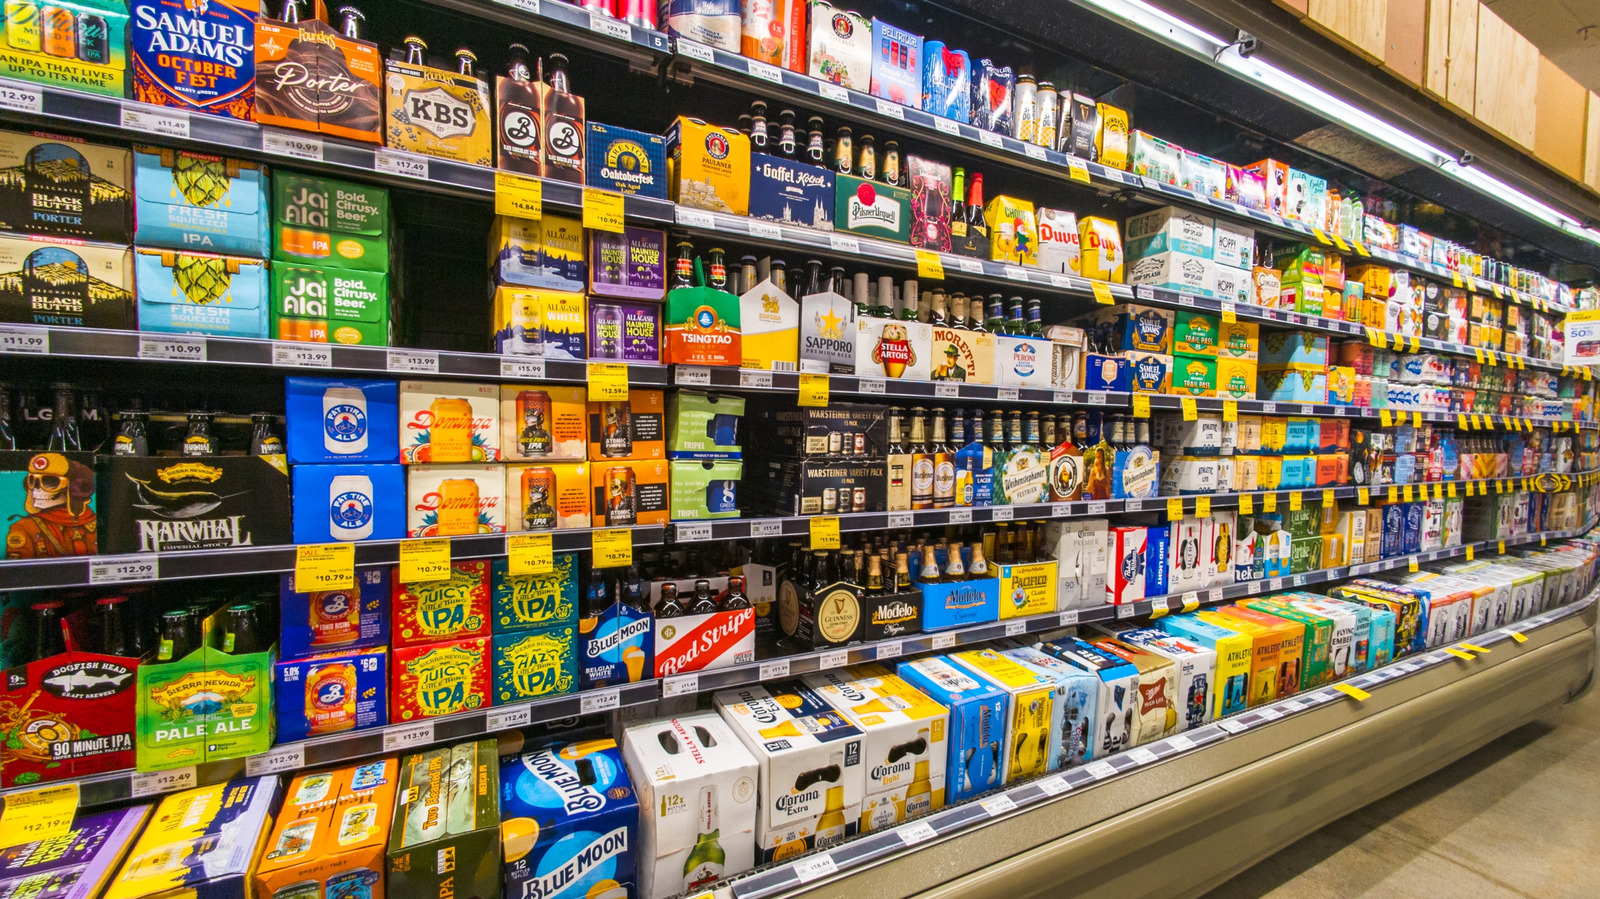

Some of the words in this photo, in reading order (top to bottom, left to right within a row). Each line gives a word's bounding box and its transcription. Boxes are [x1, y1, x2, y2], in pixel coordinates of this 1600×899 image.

[136, 5, 254, 51] SAMUEL
[772, 22, 782, 34] 4x
[298, 28, 336, 50] Founders
[654, 38, 662, 46] 5
[148, 32, 244, 68] ADAMS
[15, 57, 42, 69] IPA
[44, 63, 78, 77] THAT
[81, 70, 114, 81] LIVES
[157, 53, 237, 79] OCTOBER
[8, 64, 26, 76] UP
[28, 67, 47, 79] TO
[49, 70, 68, 82] ITS
[69, 74, 106, 88] NAME
[176, 70, 218, 88] FEST
[274, 62, 364, 93] Porter
[423, 68, 455, 90] Founders
[411, 97, 469, 129] KBS
[158, 119, 186, 130] $11.49
[34, 131, 84, 143] DESCHUTES
[608, 142, 648, 172] FIRESTONE
[702, 158, 732, 170] PAULANER
[763, 163, 794, 183] Gaffel
[32, 200, 82, 212] BUTTE
[33, 193, 82, 206] BLACK
[512, 201, 534, 210] $14.84
[168, 204, 228, 221] FRESH
[33, 213, 82, 226] PORTER
[168, 214, 228, 228] SQUEEZED
[183, 232, 214, 246] IPA
[546, 230, 580, 242] ALLAGASH
[312, 240, 328, 250] IPA
[1219, 236, 1237, 250] HOPPY
[631, 254, 659, 265] HOUSE
[290, 277, 327, 296] Jai
[334, 278, 366, 290] Bold.
[1218, 278, 1234, 291] HOPPY
[334, 287, 378, 302] Citrusy.
[284, 295, 327, 316] Alai
[334, 297, 366, 308] Beer.
[547, 312, 580, 322] WHITE
[1139, 316, 1161, 328] SAMUEL
[626, 328, 654, 337] HOUSE
[1141, 325, 1160, 336] ADAMS
[682, 333, 732, 344] TSINGTAO
[806, 336, 852, 354] SAPPORO
[165, 344, 202, 354] $10.99
[806, 348, 833, 358] PREMIUM
[881, 342, 908, 352] STELLA
[934, 330, 976, 376] MORETTI
[297, 352, 328, 361] $13.99
[881, 350, 908, 360] ARTOIS
[1013, 352, 1036, 362] PERONI
[328, 406, 342, 420] FAT
[344, 406, 364, 420] TIRE
[809, 410, 850, 419] WARSTEINER
[407, 410, 494, 438] Dominga
[336, 433, 358, 441] ALE
[684, 442, 705, 450] TRIPEL
[808, 468, 848, 478] WARSTEINER
[850, 468, 870, 477] VARIETY
[870, 468, 883, 476] PACK
[1016, 486, 1038, 499] FESTBIER
[415, 492, 500, 517] Dominga
[136, 514, 252, 552] NARWHAL
[1078, 530, 1096, 539] Corona
[1074, 538, 1098, 547] PREMIER
[117, 565, 152, 574] $12.99
[316, 574, 344, 582] $10.79
[1012, 575, 1048, 590] PACIFICO
[1064, 580, 1074, 590] 90
[950, 588, 982, 605] Modelo
[824, 614, 853, 623] GUINNESS
[877, 604, 913, 620] Modelo
[586, 634, 620, 658] BLUE
[620, 620, 649, 640] MOON
[660, 648, 700, 676] Red
[700, 608, 754, 652] Stripe
[1228, 648, 1252, 662] ATHLETIC
[1256, 642, 1280, 656] ATHLETIC
[518, 652, 556, 670] HAZY
[52, 662, 100, 676] DOGFISH
[101, 663, 127, 674] HEAD
[423, 666, 466, 684] JUICY
[586, 664, 616, 674] BELGIAN
[590, 670, 612, 678] WHITE
[518, 670, 556, 692] IPA
[166, 681, 202, 697] SIERRA
[204, 680, 242, 690] NEVADA
[422, 682, 464, 709] IPA
[155, 722, 208, 742] PALE
[215, 718, 252, 732] ALE
[670, 718, 688, 736] ARTOIS
[934, 721, 942, 732] 12
[404, 730, 430, 740] $13.99
[53, 742, 70, 756] 90
[73, 736, 110, 754] MINUTE
[112, 732, 132, 750] IPA
[848, 743, 858, 755] 12
[683, 738, 706, 765] STELLA
[269, 754, 300, 764] $12.99
[429, 756, 442, 771] IPA
[871, 762, 910, 780] Corona
[158, 773, 192, 784] $12.49
[882, 773, 900, 786] Light
[425, 770, 441, 806] Hearted
[554, 772, 602, 812] BLUE
[667, 794, 684, 806] 12x
[775, 790, 820, 812] Corona
[906, 800, 930, 813] Corona
[786, 804, 808, 816] Extra
[423, 806, 439, 830] Two
[24, 820, 60, 832] $12.19
[520, 862, 575, 899] BLUE
[577, 831, 625, 874] MOON
